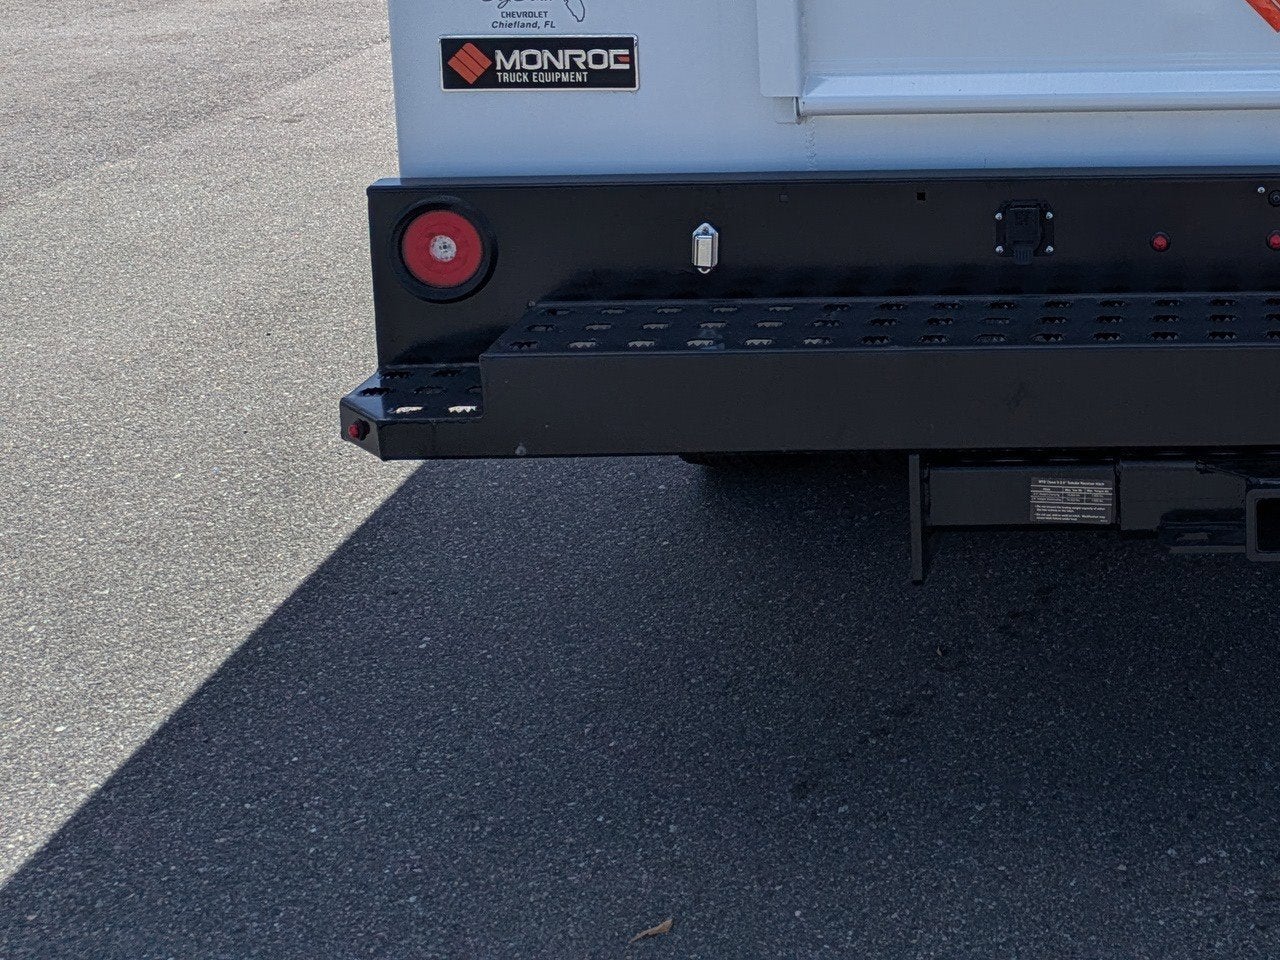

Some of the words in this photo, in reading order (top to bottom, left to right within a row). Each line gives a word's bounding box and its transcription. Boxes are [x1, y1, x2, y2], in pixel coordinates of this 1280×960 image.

[501, 11, 549, 19] CHEVROLET
[491, 20, 541, 29] Chiefland,
[544, 20, 556, 29] FL
[495, 48, 630, 70] MONROE
[496, 71, 529, 83] TRUCK
[532, 71, 589, 83] EQUIPMENT
